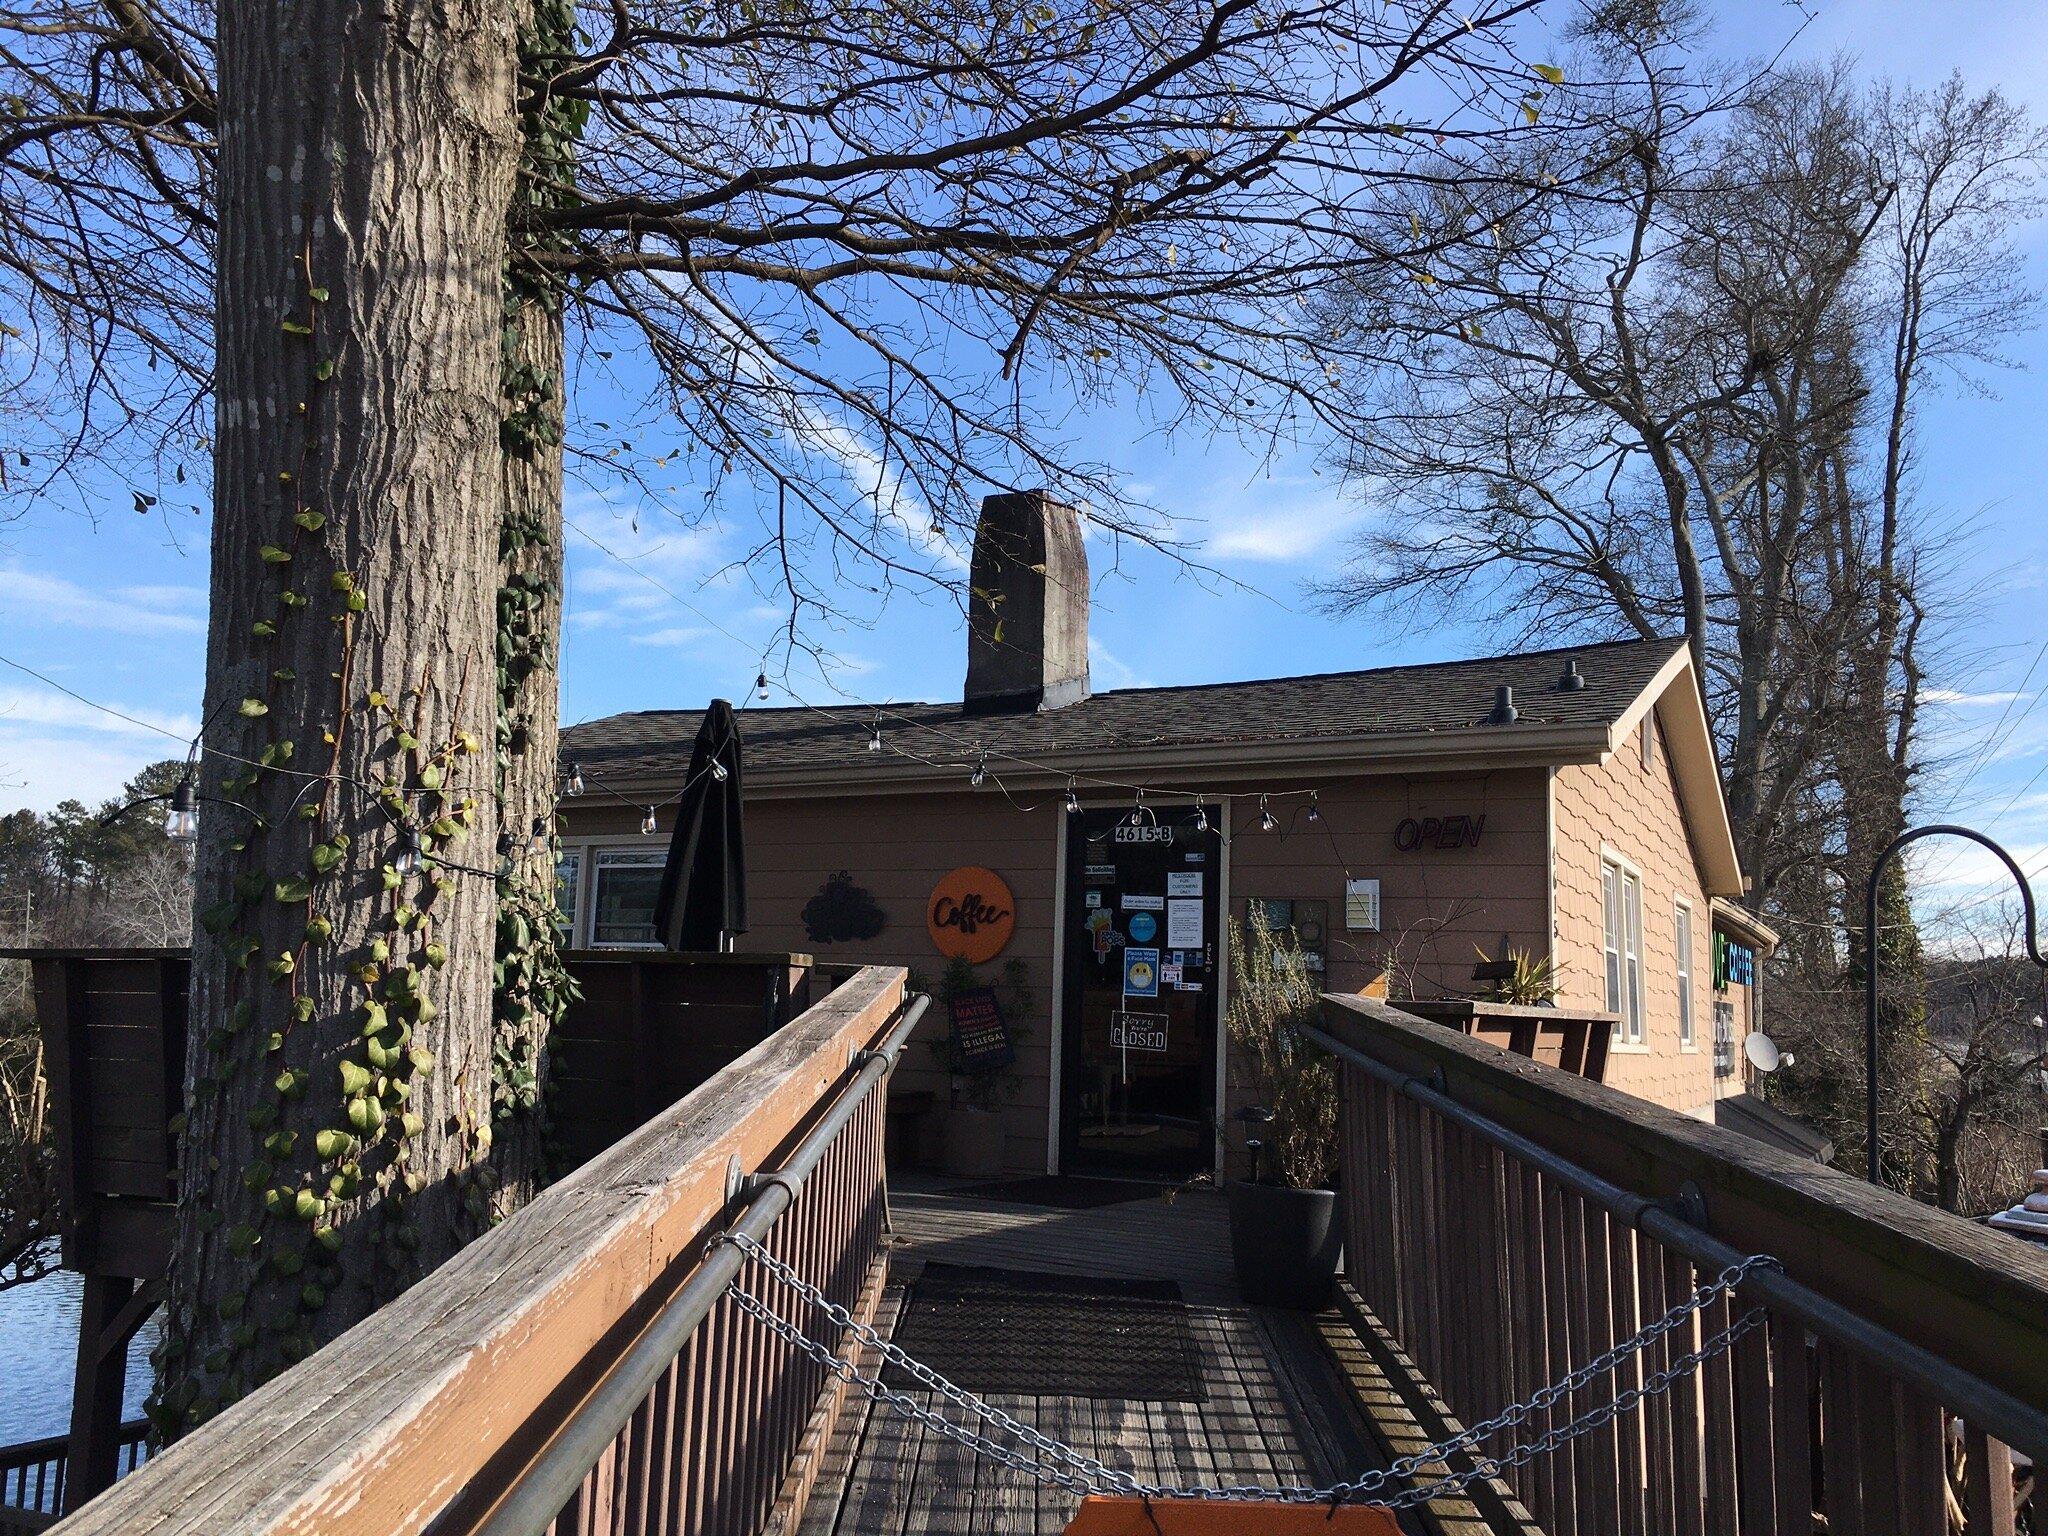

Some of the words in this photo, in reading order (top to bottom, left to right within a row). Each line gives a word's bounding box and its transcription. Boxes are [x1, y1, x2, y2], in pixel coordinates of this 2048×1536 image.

[1394, 814, 1486, 851] OPEN
[933, 893, 1010, 934] Coffee
[1101, 936, 1125, 945] POPS
[956, 1004, 995, 1019] MATTER
[1122, 1014, 1154, 1028] Sorry
[962, 1040, 971, 1048] IS
[972, 1032, 1006, 1046] ILLEGAL
[1113, 1027, 1164, 1048] CLOSED
